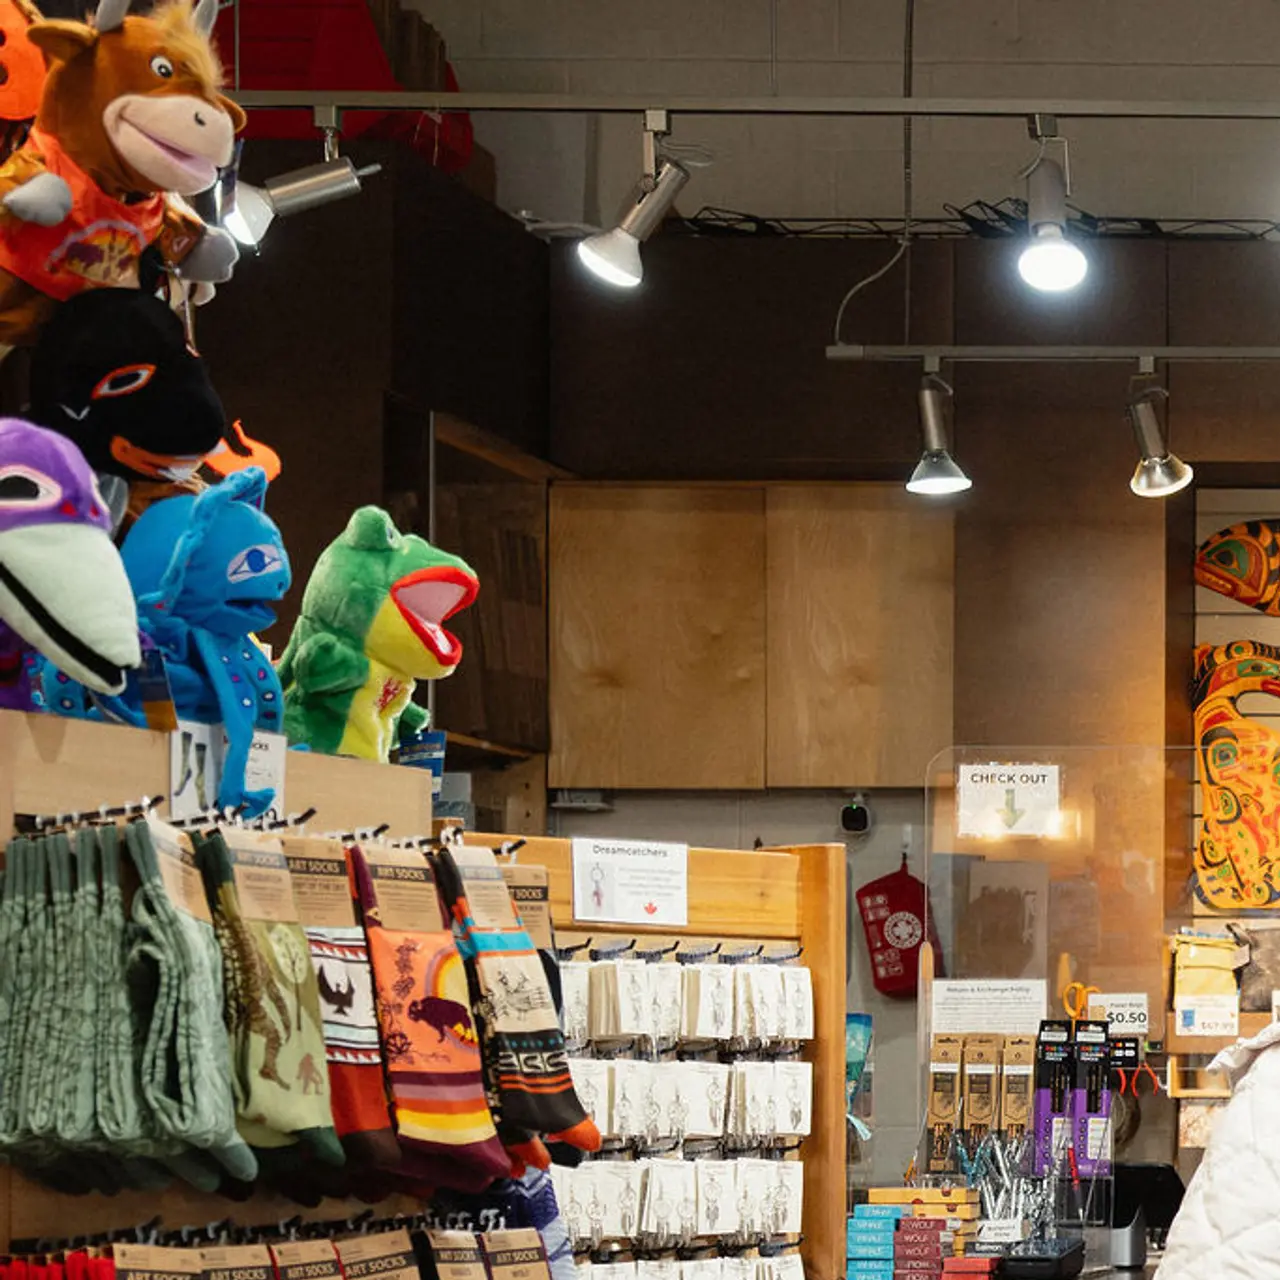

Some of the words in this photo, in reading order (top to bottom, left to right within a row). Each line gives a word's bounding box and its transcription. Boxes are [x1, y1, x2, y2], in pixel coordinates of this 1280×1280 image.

[970, 773, 1016, 784] CHECK
[1021, 773, 1048, 784] OUT
[592, 844, 668, 857] Dreamcatchers
[309, 860, 341, 874] SOCKS
[397, 868, 425, 881] SOCKS
[515, 888, 543, 899] SOCKS
[1106, 1011, 1147, 1025] $0.50
[911, 1221, 934, 1229] WOLF
[454, 1251, 475, 1261] SOCKS
[496, 1253, 512, 1263] ART
[513, 1250, 539, 1261] SOCKS
[287, 1267, 304, 1279] ART
[305, 1263, 334, 1276] SOCKS
[346, 1265, 368, 1277] ART
[369, 1256, 406, 1272] SOCKS
